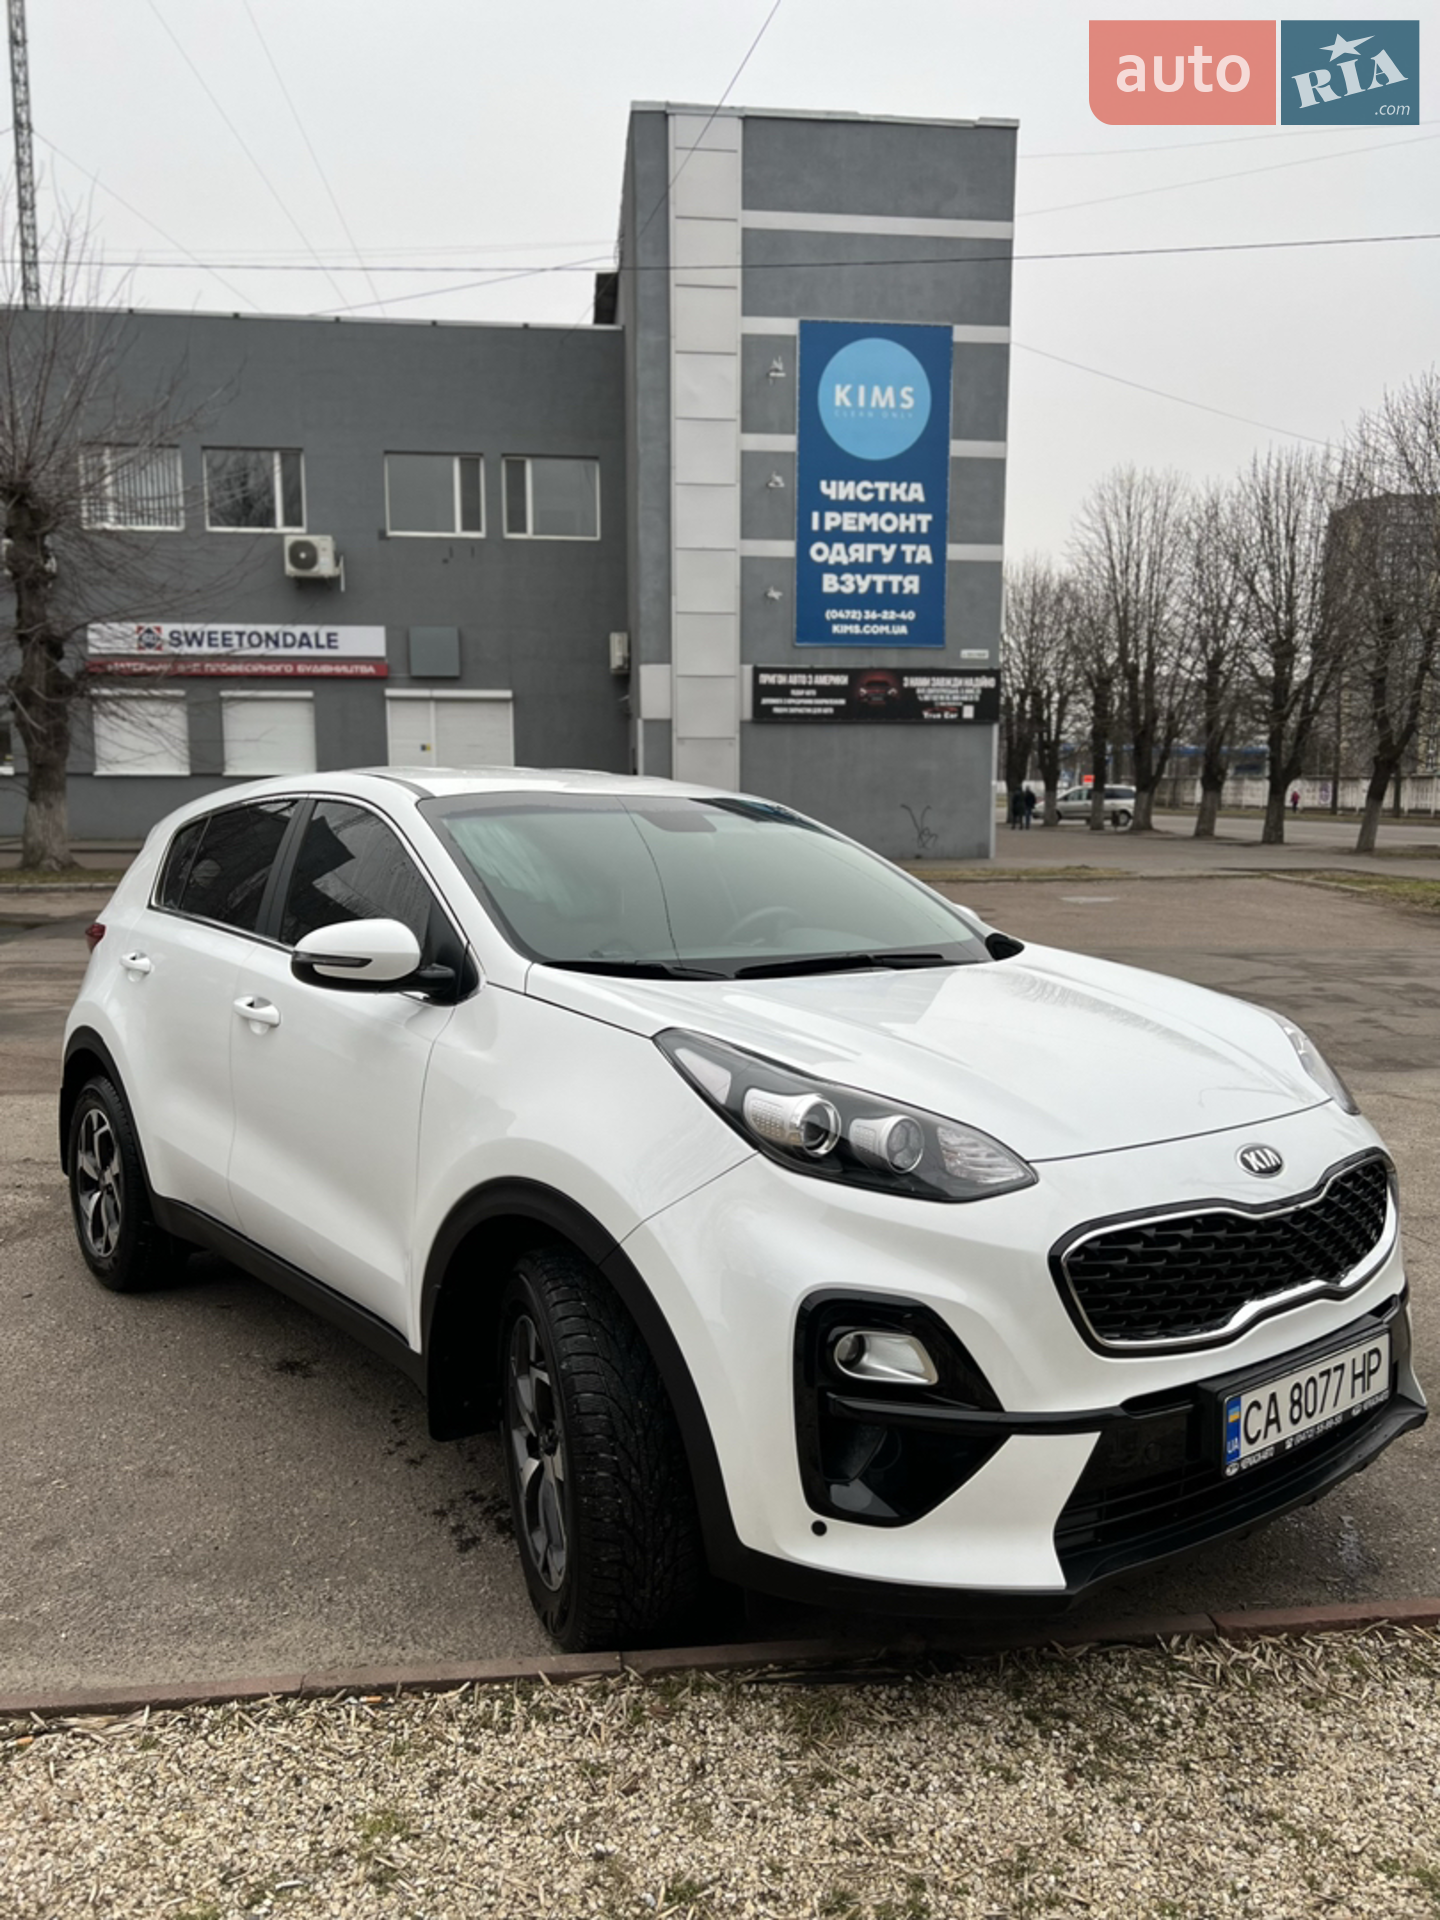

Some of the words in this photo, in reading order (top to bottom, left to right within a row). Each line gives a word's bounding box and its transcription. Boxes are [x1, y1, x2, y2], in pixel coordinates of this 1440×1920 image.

[834, 384, 915, 410] KIMS
[820, 480, 925, 502] ЧИСТКА
[824, 512, 933, 534] РЕМОНТ
[809, 542, 897, 566] ОДЯГУ
[901, 544, 933, 564] ТА
[822, 573, 920, 594] ВЗУТТЯ
[825, 609, 862, 621] (0472)
[168, 630, 339, 650] SWEETONDALE
[832, 624, 908, 635] KIMS.COM.UA
[1243, 1391, 1282, 1446] CA
[1289, 1362, 1346, 1426] 8077
[1350, 1346, 1383, 1400] HP
